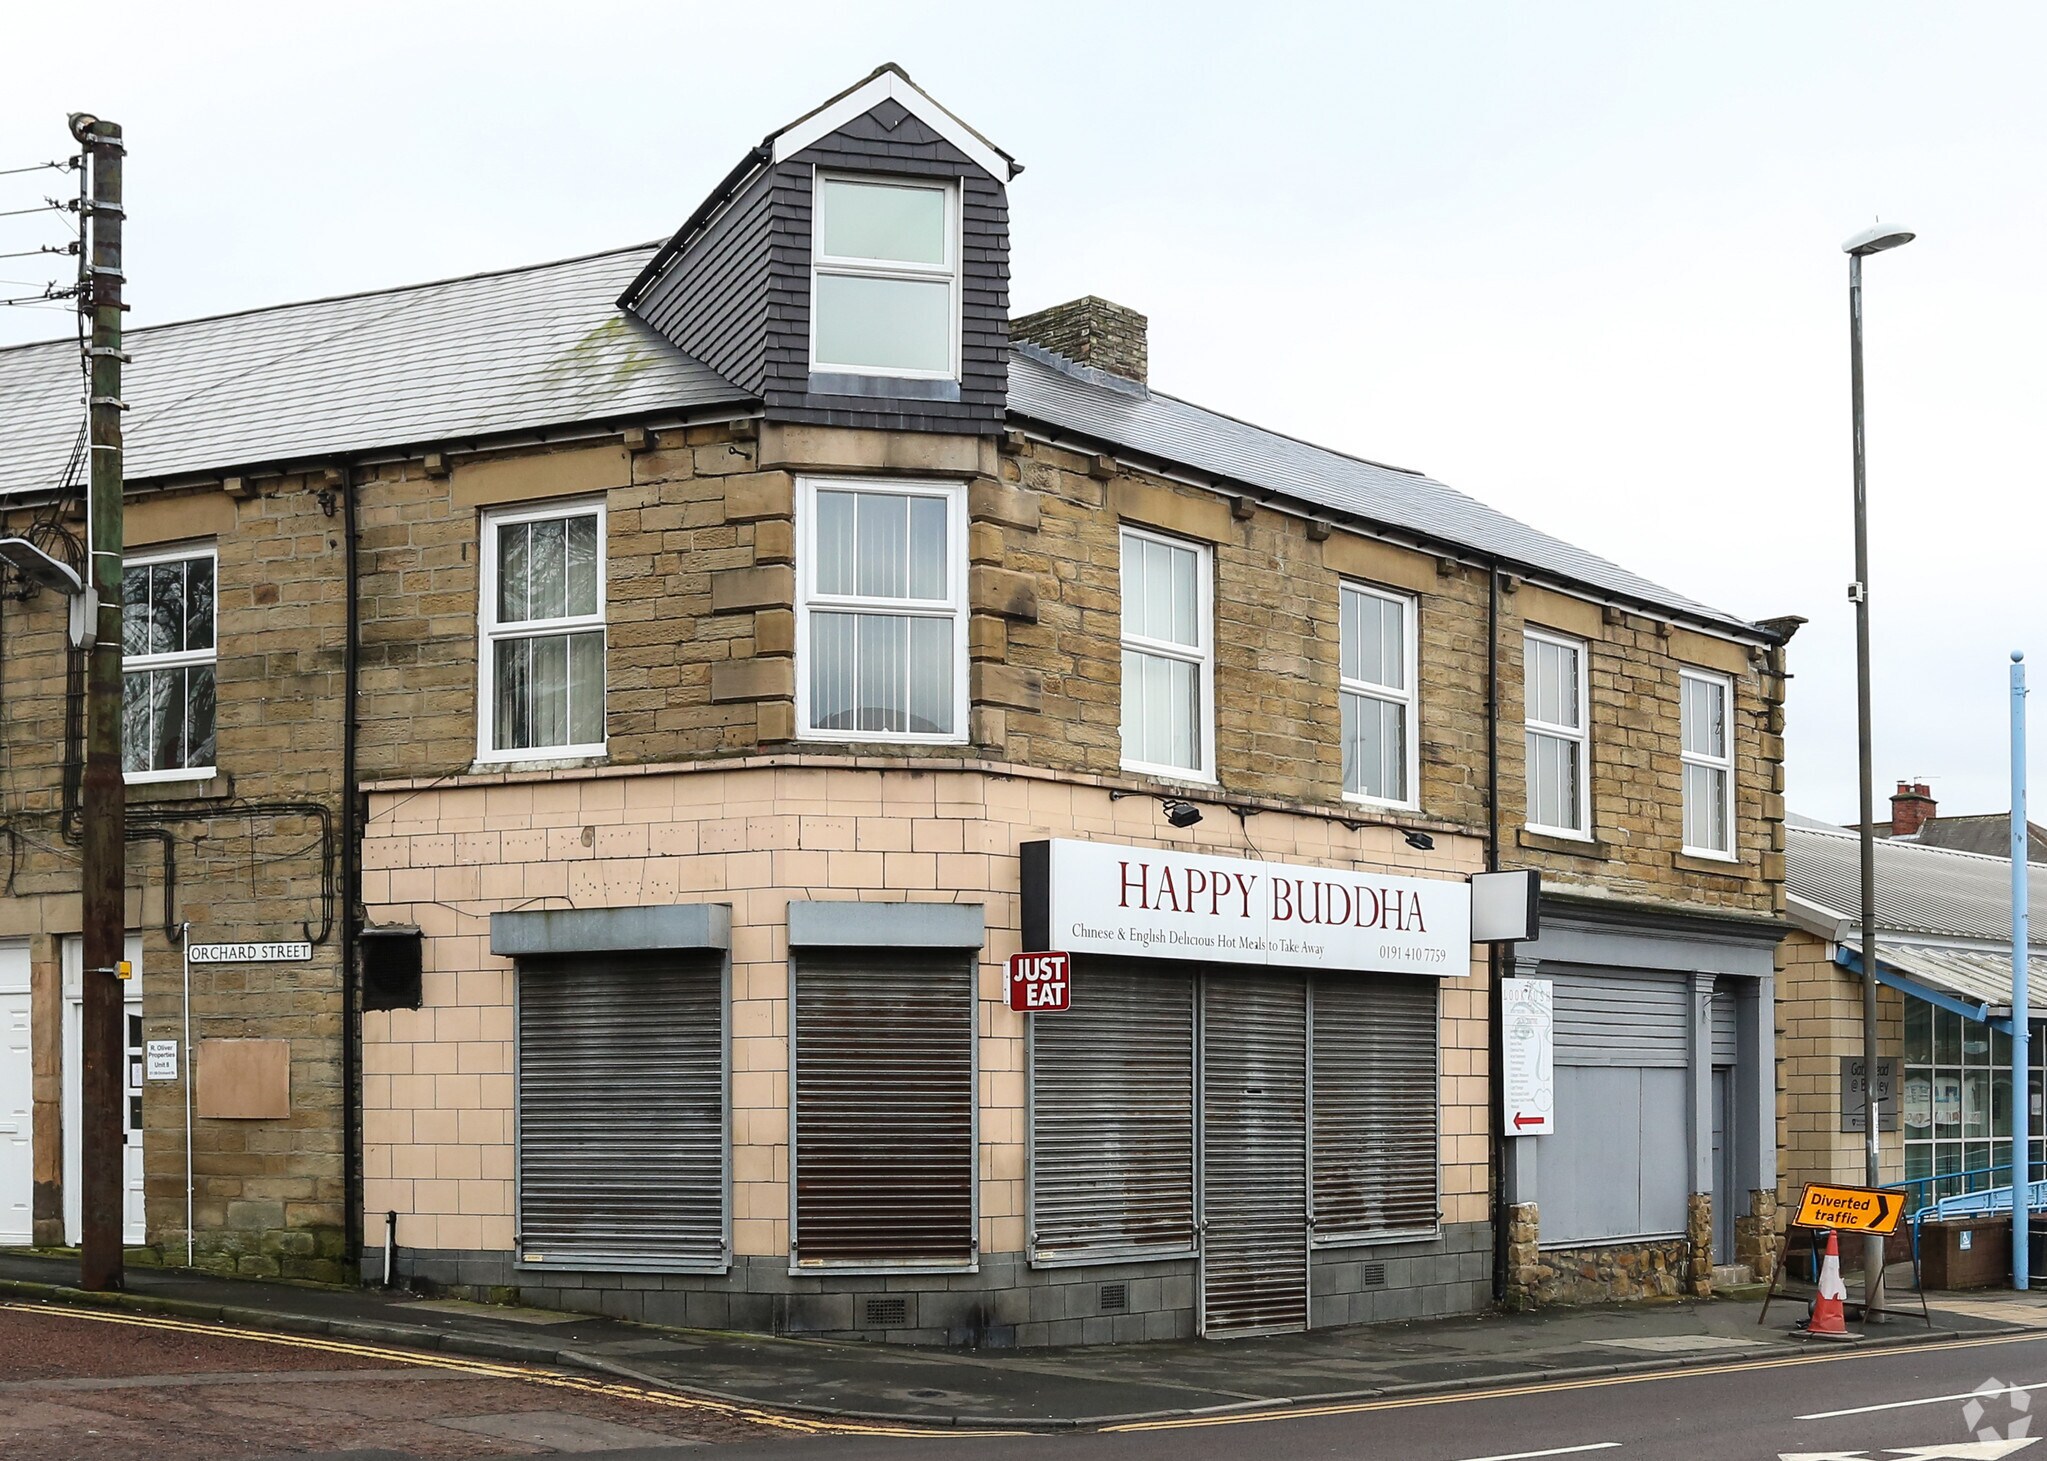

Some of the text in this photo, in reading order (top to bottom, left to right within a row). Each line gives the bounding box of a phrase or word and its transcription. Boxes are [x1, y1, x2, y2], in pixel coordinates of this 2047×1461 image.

[1118, 861, 1427, 933] HAPPY BUDDHA
[1072, 923, 1325, 960] Chinese & English Delicious Hot Meals to Take Away
[191, 944, 309, 960] ORCHARD STREET
[1379, 944, 1446, 963] 0191 410 7759
[1013, 956, 1066, 982] JUST
[1026, 982, 1066, 1007] EAT
[148, 1051, 176, 1059] Properties
[1851, 1062, 1889, 1076] Gatead
[1811, 1193, 1870, 1210] Diverted
[1815, 1209, 1858, 1225] traffic
